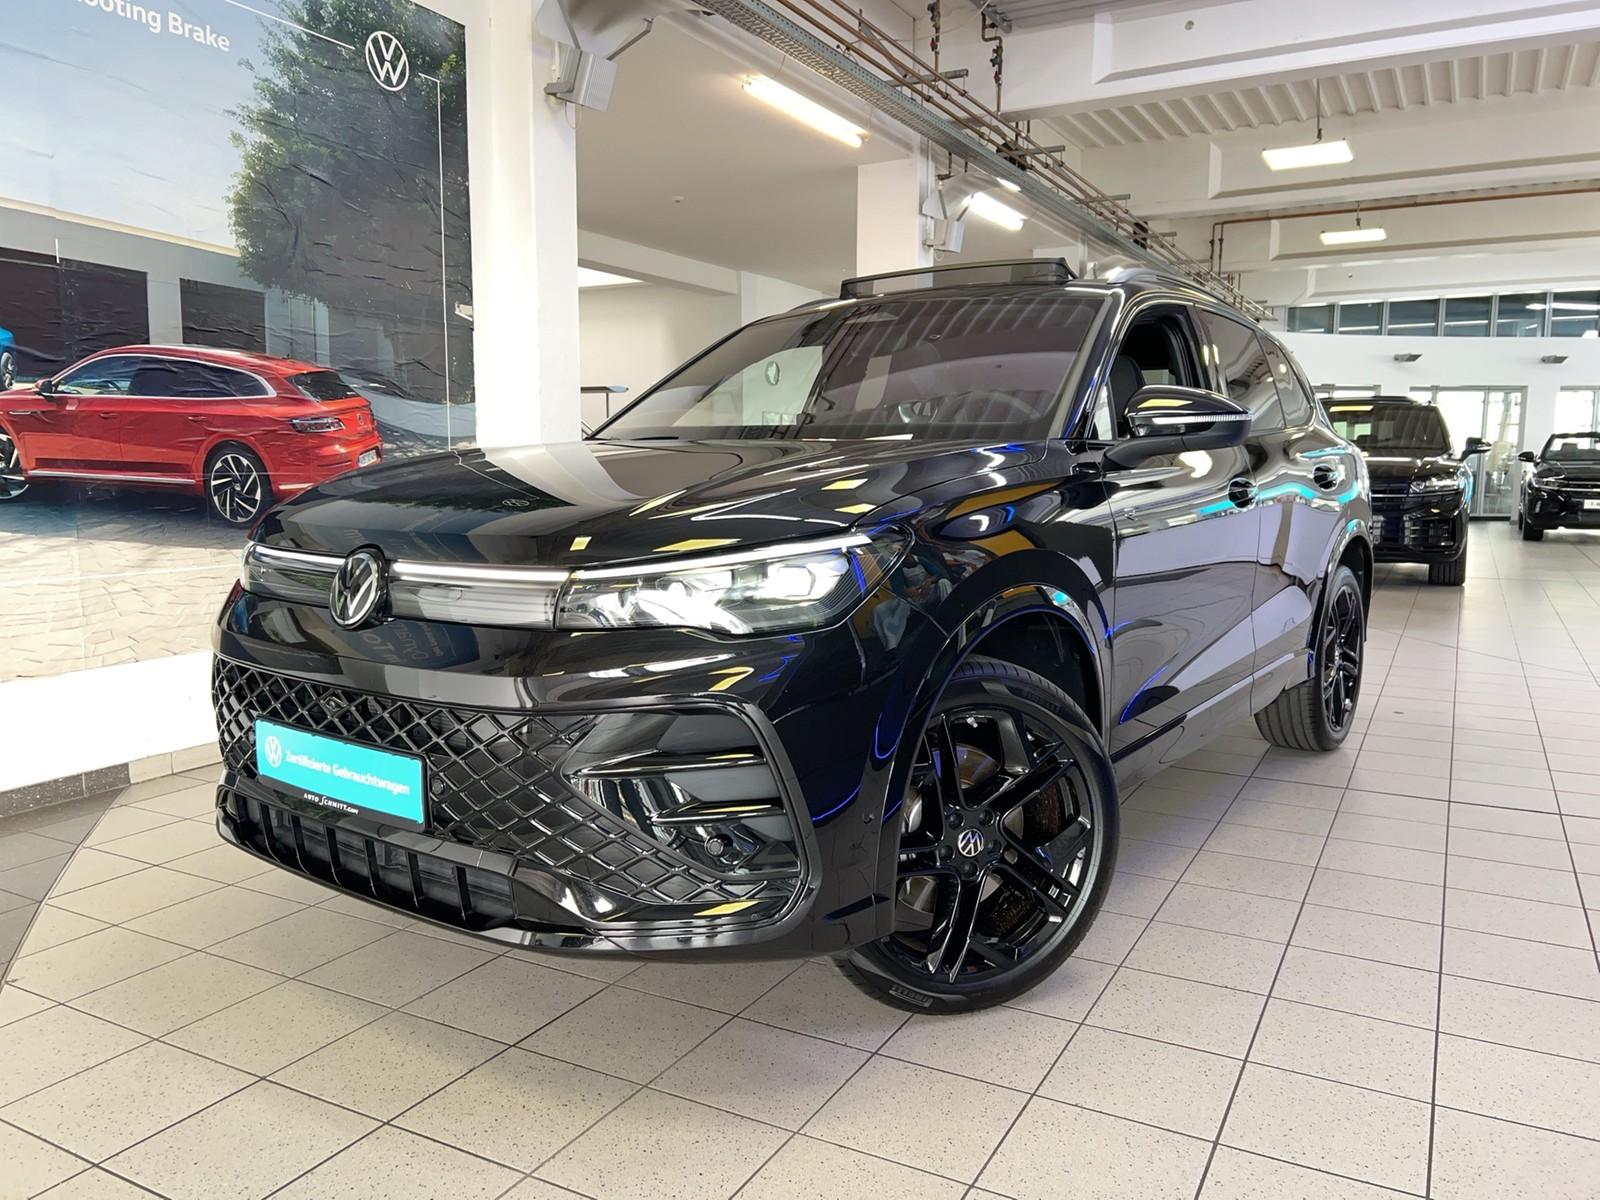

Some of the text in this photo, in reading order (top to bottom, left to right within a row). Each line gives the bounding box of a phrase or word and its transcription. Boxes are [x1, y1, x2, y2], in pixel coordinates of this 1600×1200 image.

[167, 11, 231, 51] Brake
[365, 31, 409, 91] VW
[330, 552, 378, 626] VW
[285, 750, 410, 795] Zertifizierte Gebrauchtwagen
[303, 792, 319, 803] AUTO
